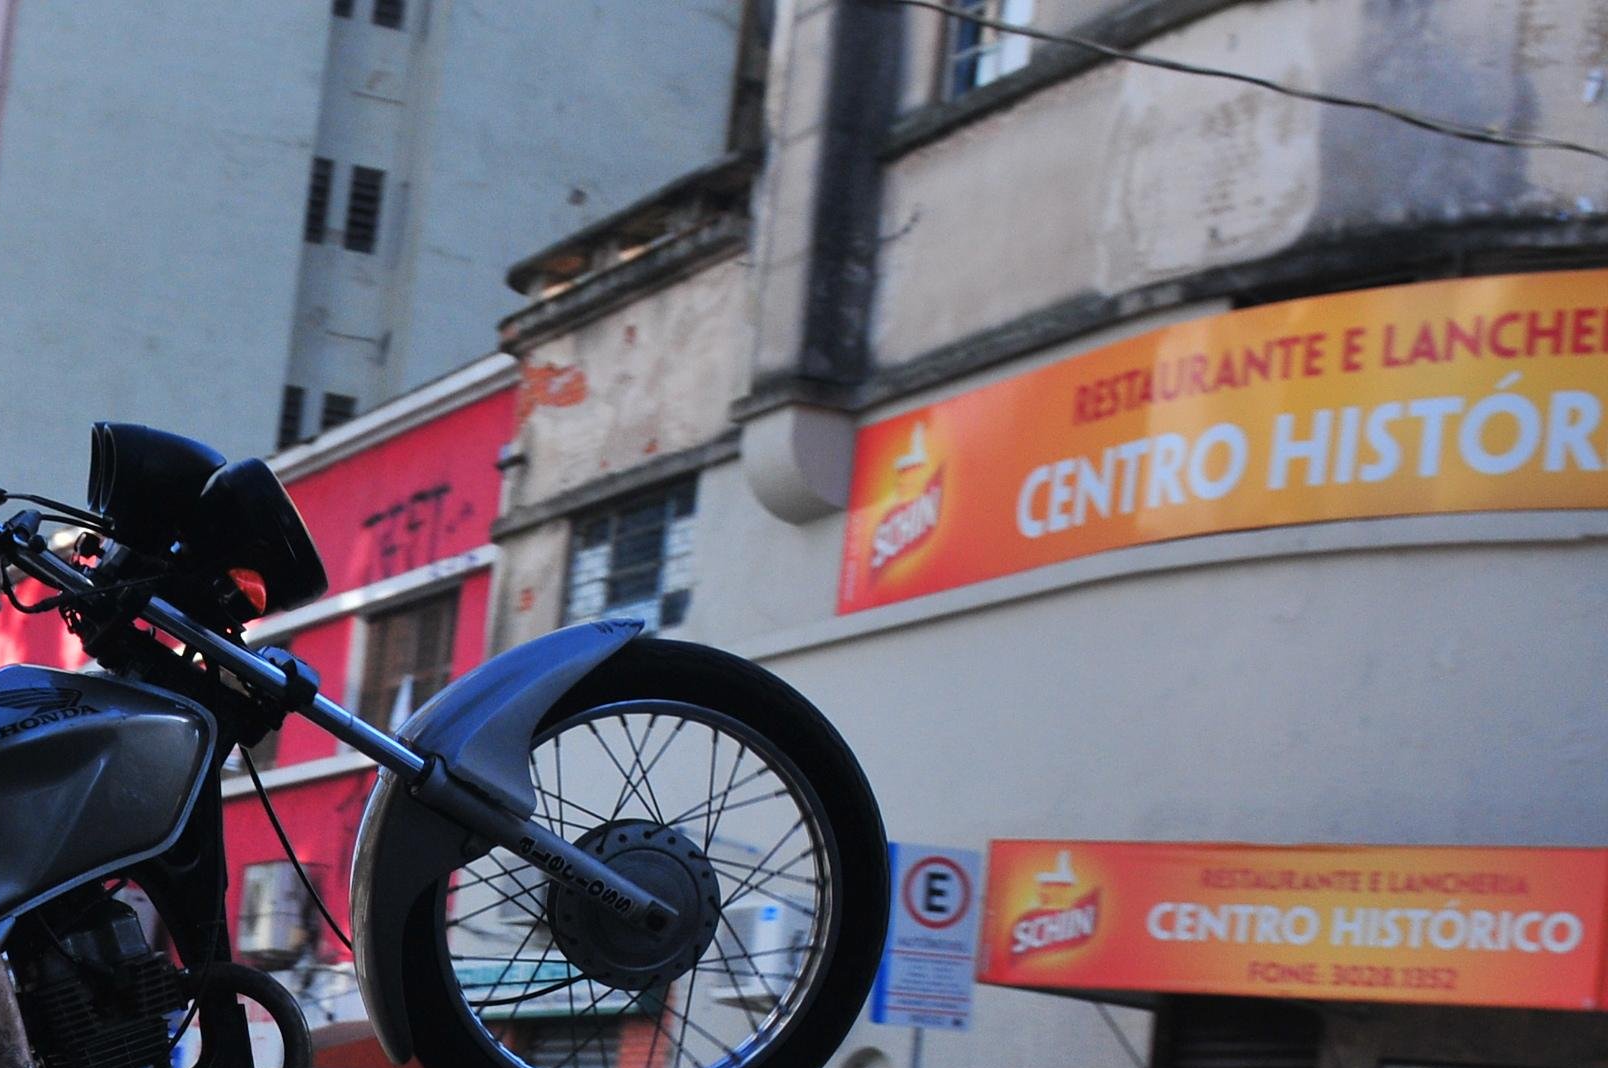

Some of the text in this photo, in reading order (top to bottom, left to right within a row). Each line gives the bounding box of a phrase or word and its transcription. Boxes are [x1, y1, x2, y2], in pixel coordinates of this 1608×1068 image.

[1072, 333, 1327, 426] RESTAURANTE
[1342, 327, 1367, 373] E
[1016, 370, 1608, 539] CENTRO HISTÓR
[871, 488, 941, 569] SCHIN
[923, 871, 952, 913] E
[1201, 868, 1362, 893] RESTAURANTE
[1369, 870, 1383, 893] E
[1012, 904, 1096, 953] SCHIN
[1147, 900, 1584, 954] CENTRO HISTÓRICO
